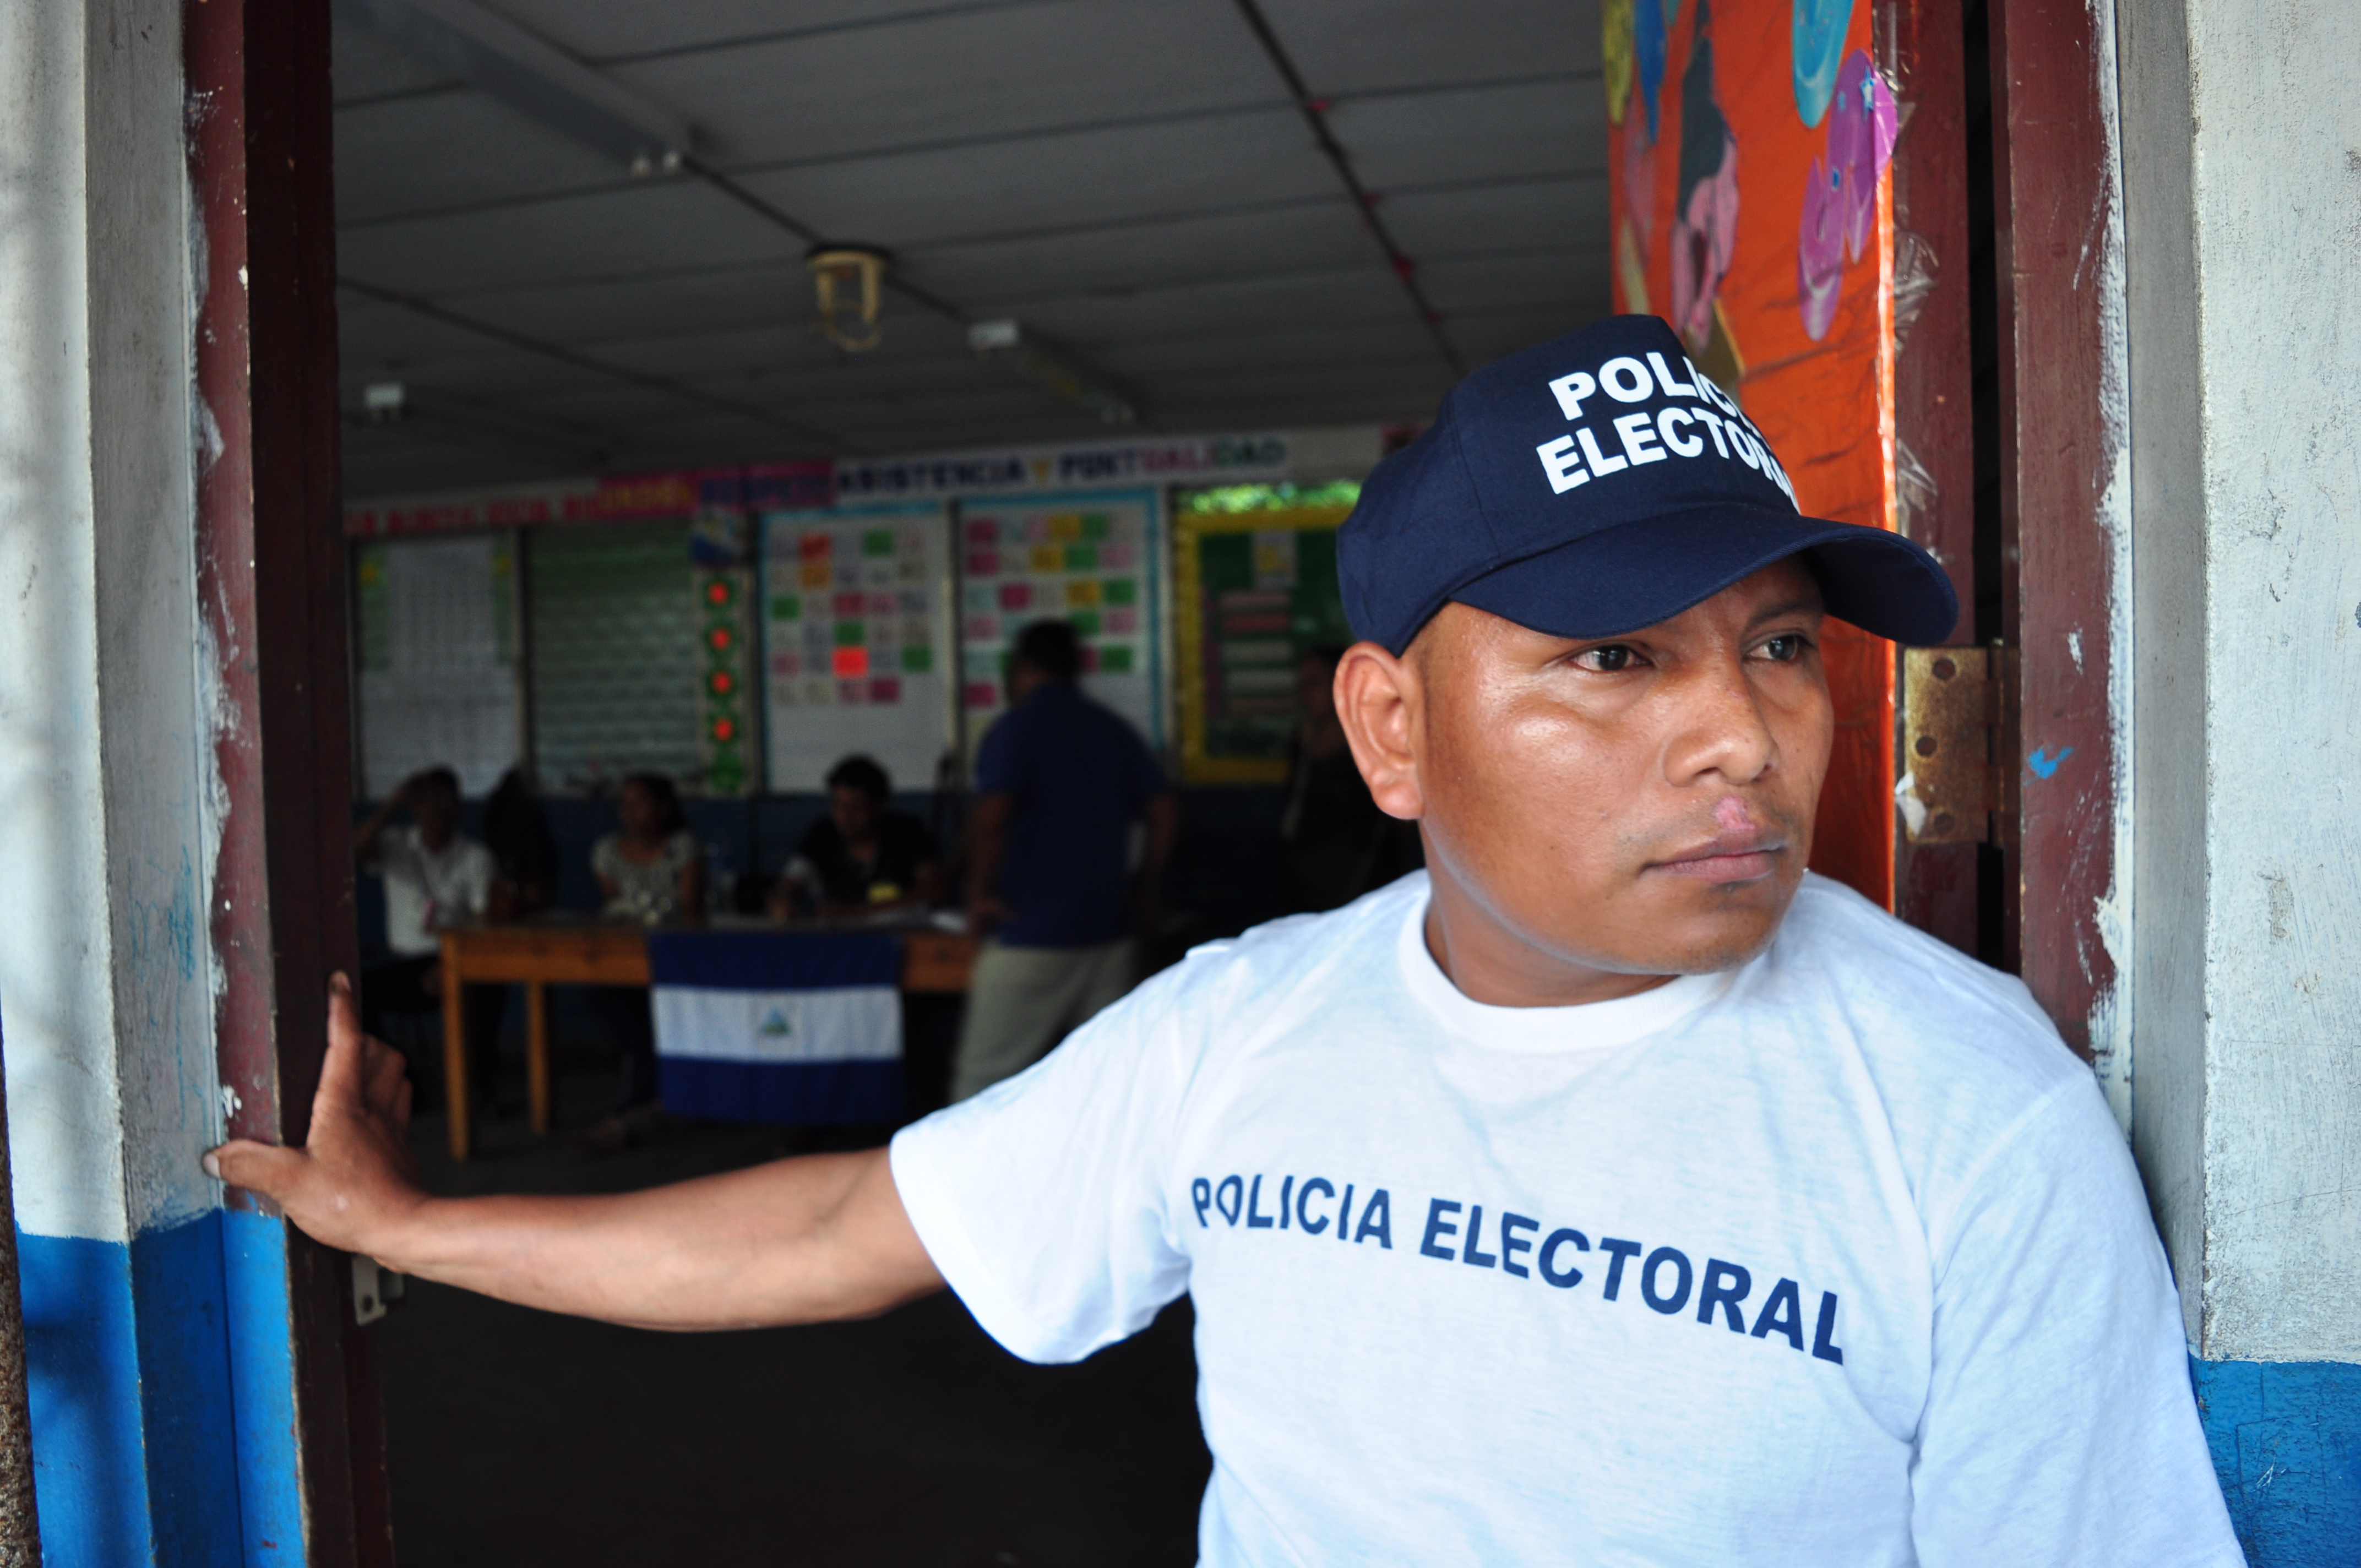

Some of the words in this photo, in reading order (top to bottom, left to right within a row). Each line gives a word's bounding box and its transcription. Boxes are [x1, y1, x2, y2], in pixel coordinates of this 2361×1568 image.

[1549, 352, 1774, 453] POLIC
[838, 457, 1024, 491] ASISTENCIA
[1059, 438, 1286, 481] PUNTUALIDAD
[1536, 407, 1801, 515] ELECTORA
[1191, 1173, 1393, 1250] POLICIA
[1419, 1197, 1845, 1366] ELECTORAL
